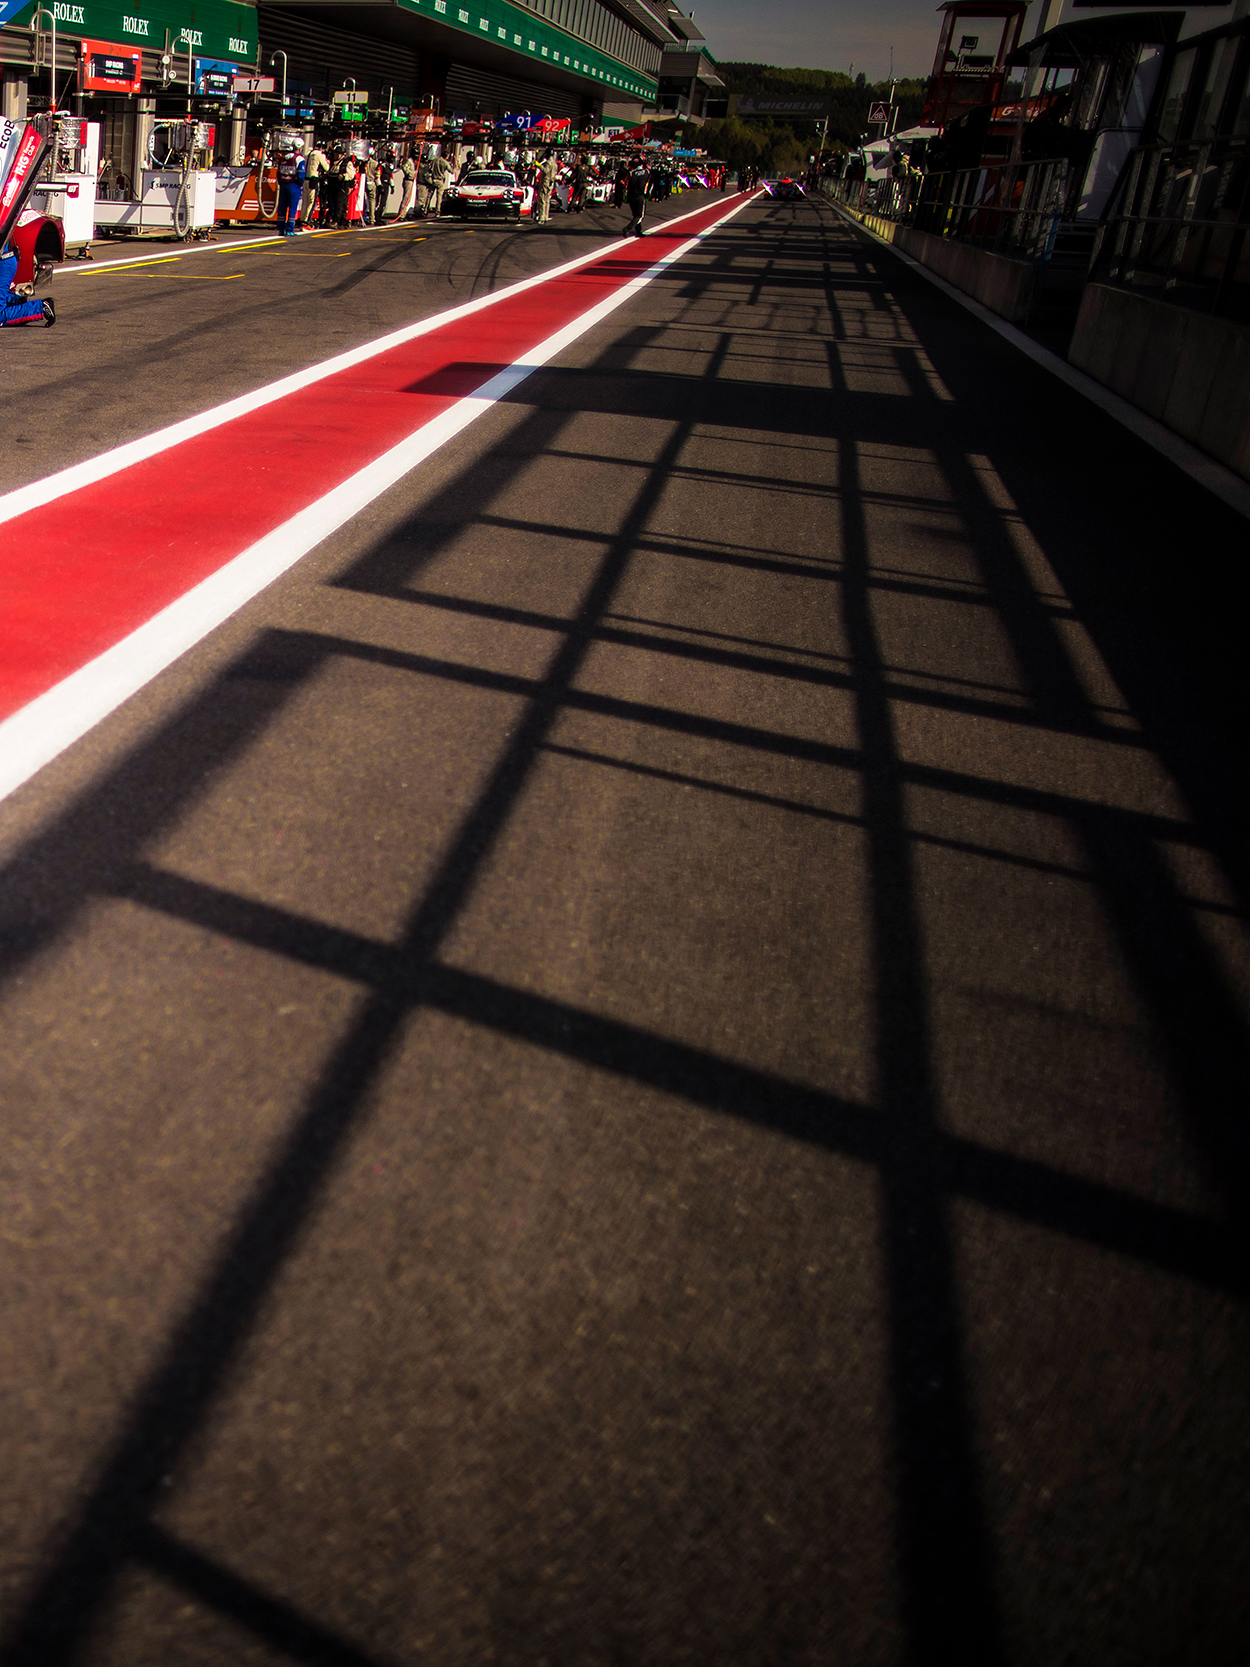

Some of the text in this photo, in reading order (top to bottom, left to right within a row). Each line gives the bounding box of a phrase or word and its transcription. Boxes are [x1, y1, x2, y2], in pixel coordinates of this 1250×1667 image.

[53, 2, 85, 23] ROLEX
[122, 16, 149, 36] ROLEX
[180, 27, 203, 46] ROLEX
[228, 37, 248, 55] ROLEX
[89, 62, 96, 78] 11
[247, 79, 260, 90] 17
[346, 92, 356, 103] 11
[757, 101, 824, 111] MICHELIN
[516, 116, 531, 128] 91
[544, 120, 559, 132] 92
[14, 156, 29, 176] IHG
[33, 190, 59, 198] RACG
